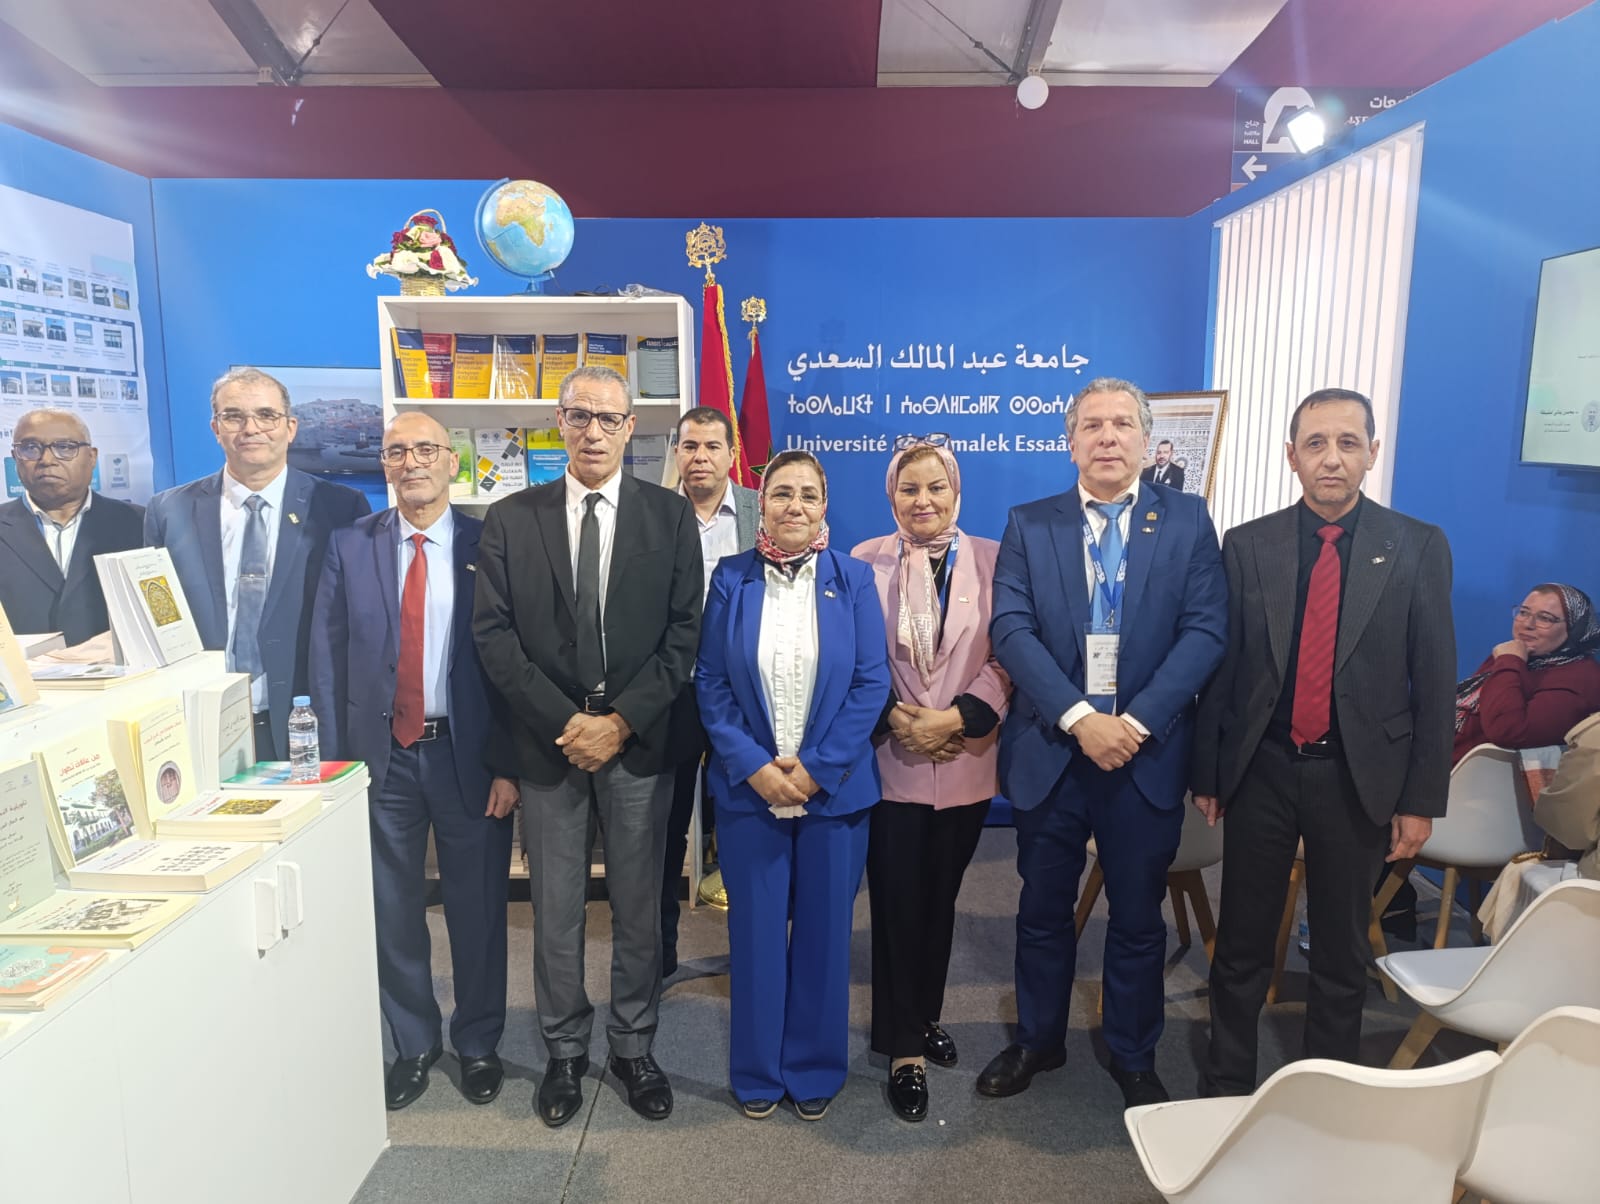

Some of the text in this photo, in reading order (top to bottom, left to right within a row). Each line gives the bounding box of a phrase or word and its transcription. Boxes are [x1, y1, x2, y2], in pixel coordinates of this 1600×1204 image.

[787, 343, 1090, 382] جامعة عبد المالك السعدي
[787, 434, 888, 452] Université
[1015, 434, 1071, 452] Essaâ
